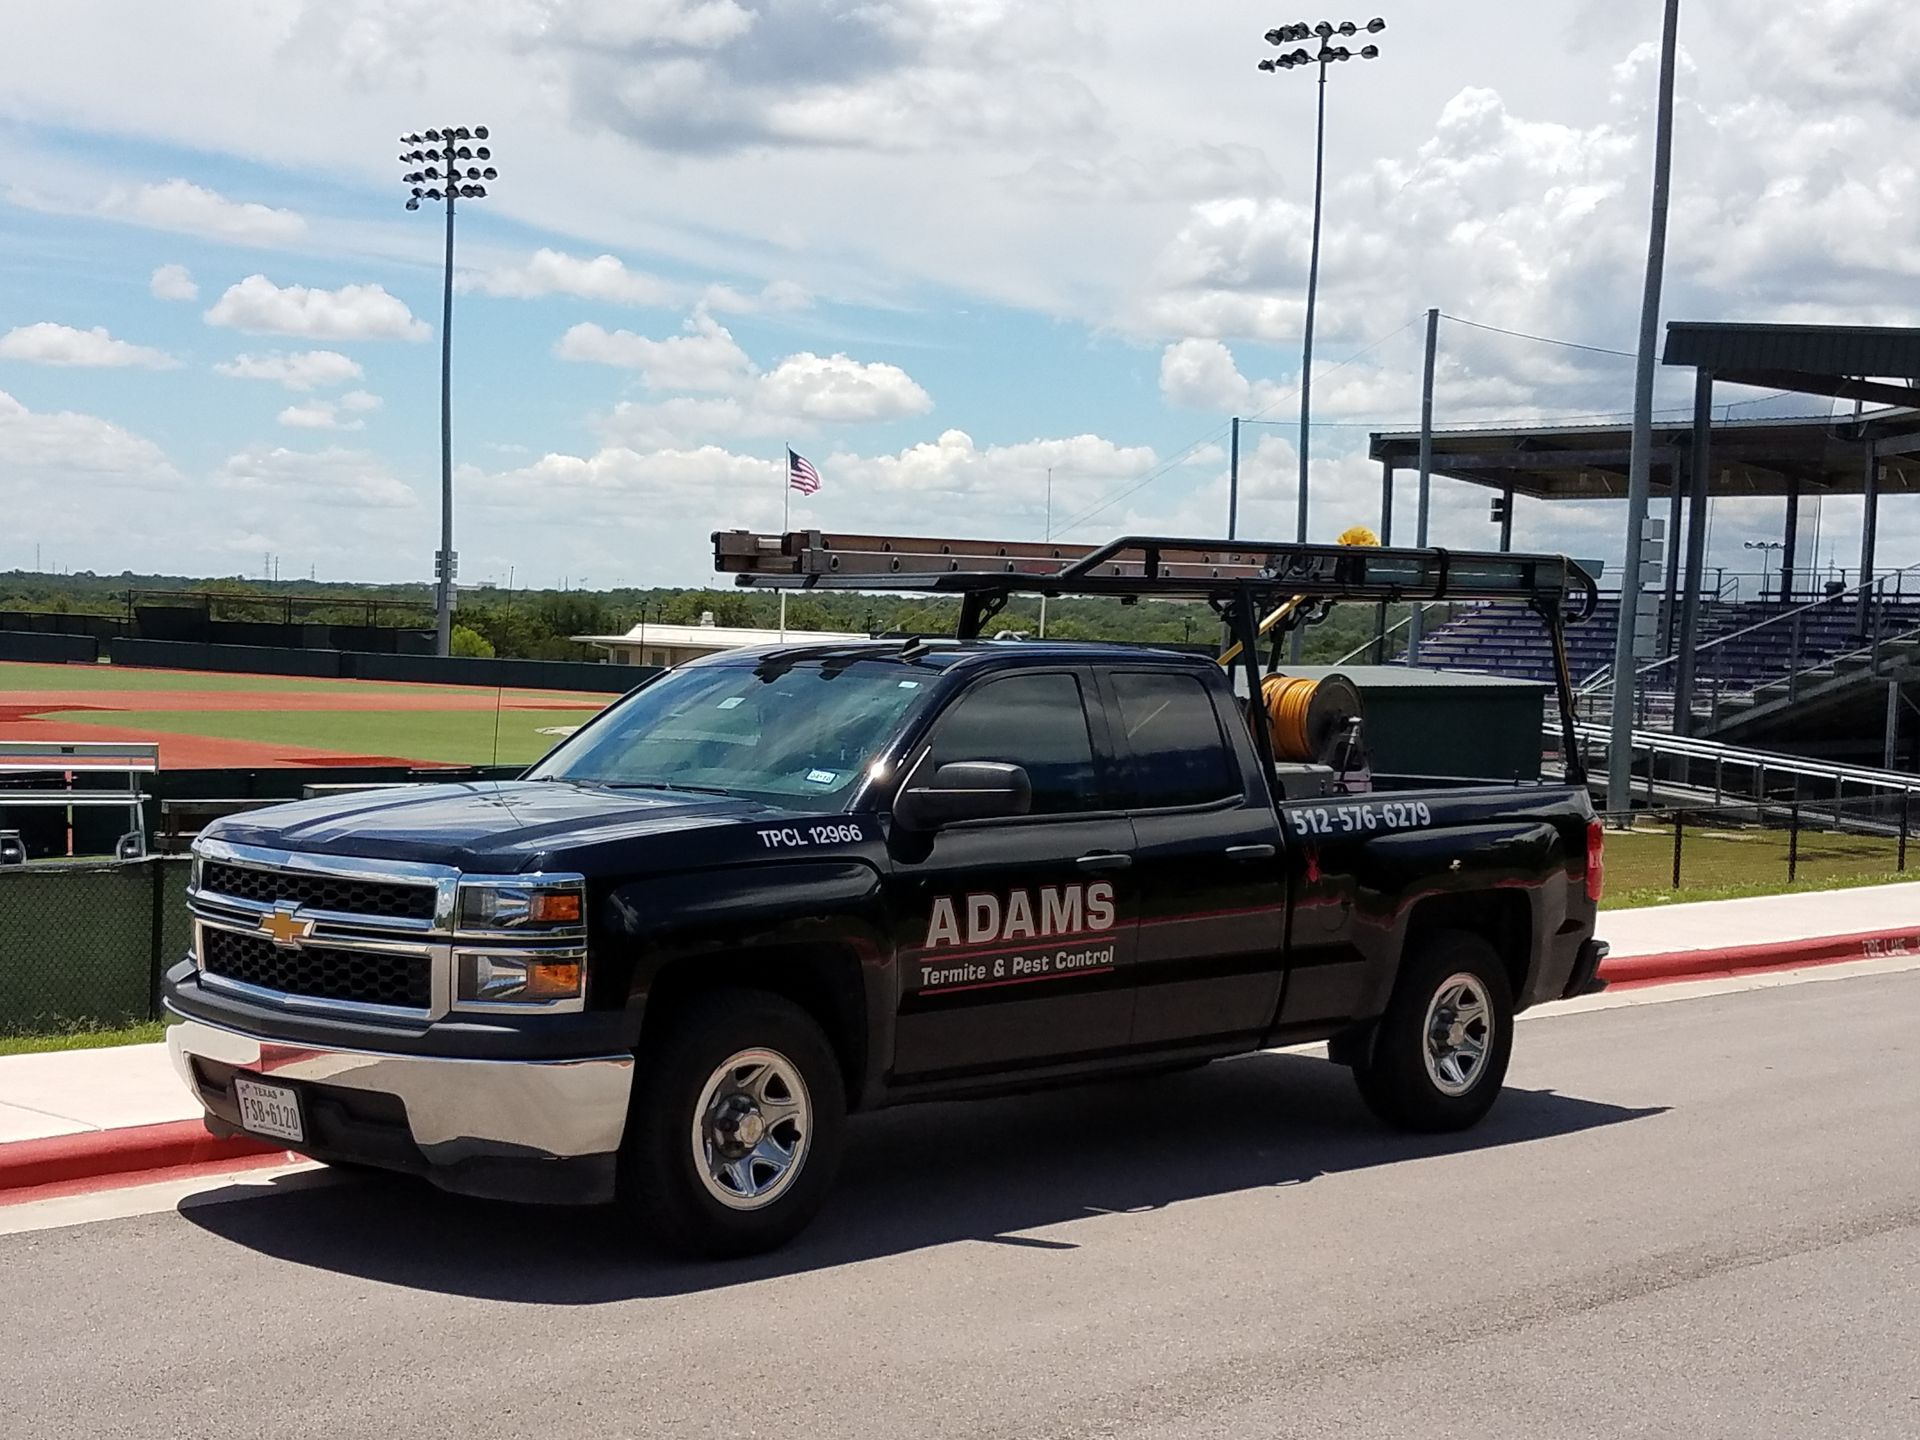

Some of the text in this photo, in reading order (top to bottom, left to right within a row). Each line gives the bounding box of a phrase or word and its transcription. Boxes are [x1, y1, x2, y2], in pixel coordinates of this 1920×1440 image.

[1291, 802, 1431, 835] 512-576-6279
[757, 824, 863, 848] TPCL 12966
[924, 882, 1115, 949] ADAMS
[921, 946, 1115, 985] Termite & Pest Control
[253, 1086, 278, 1099] TEXAS
